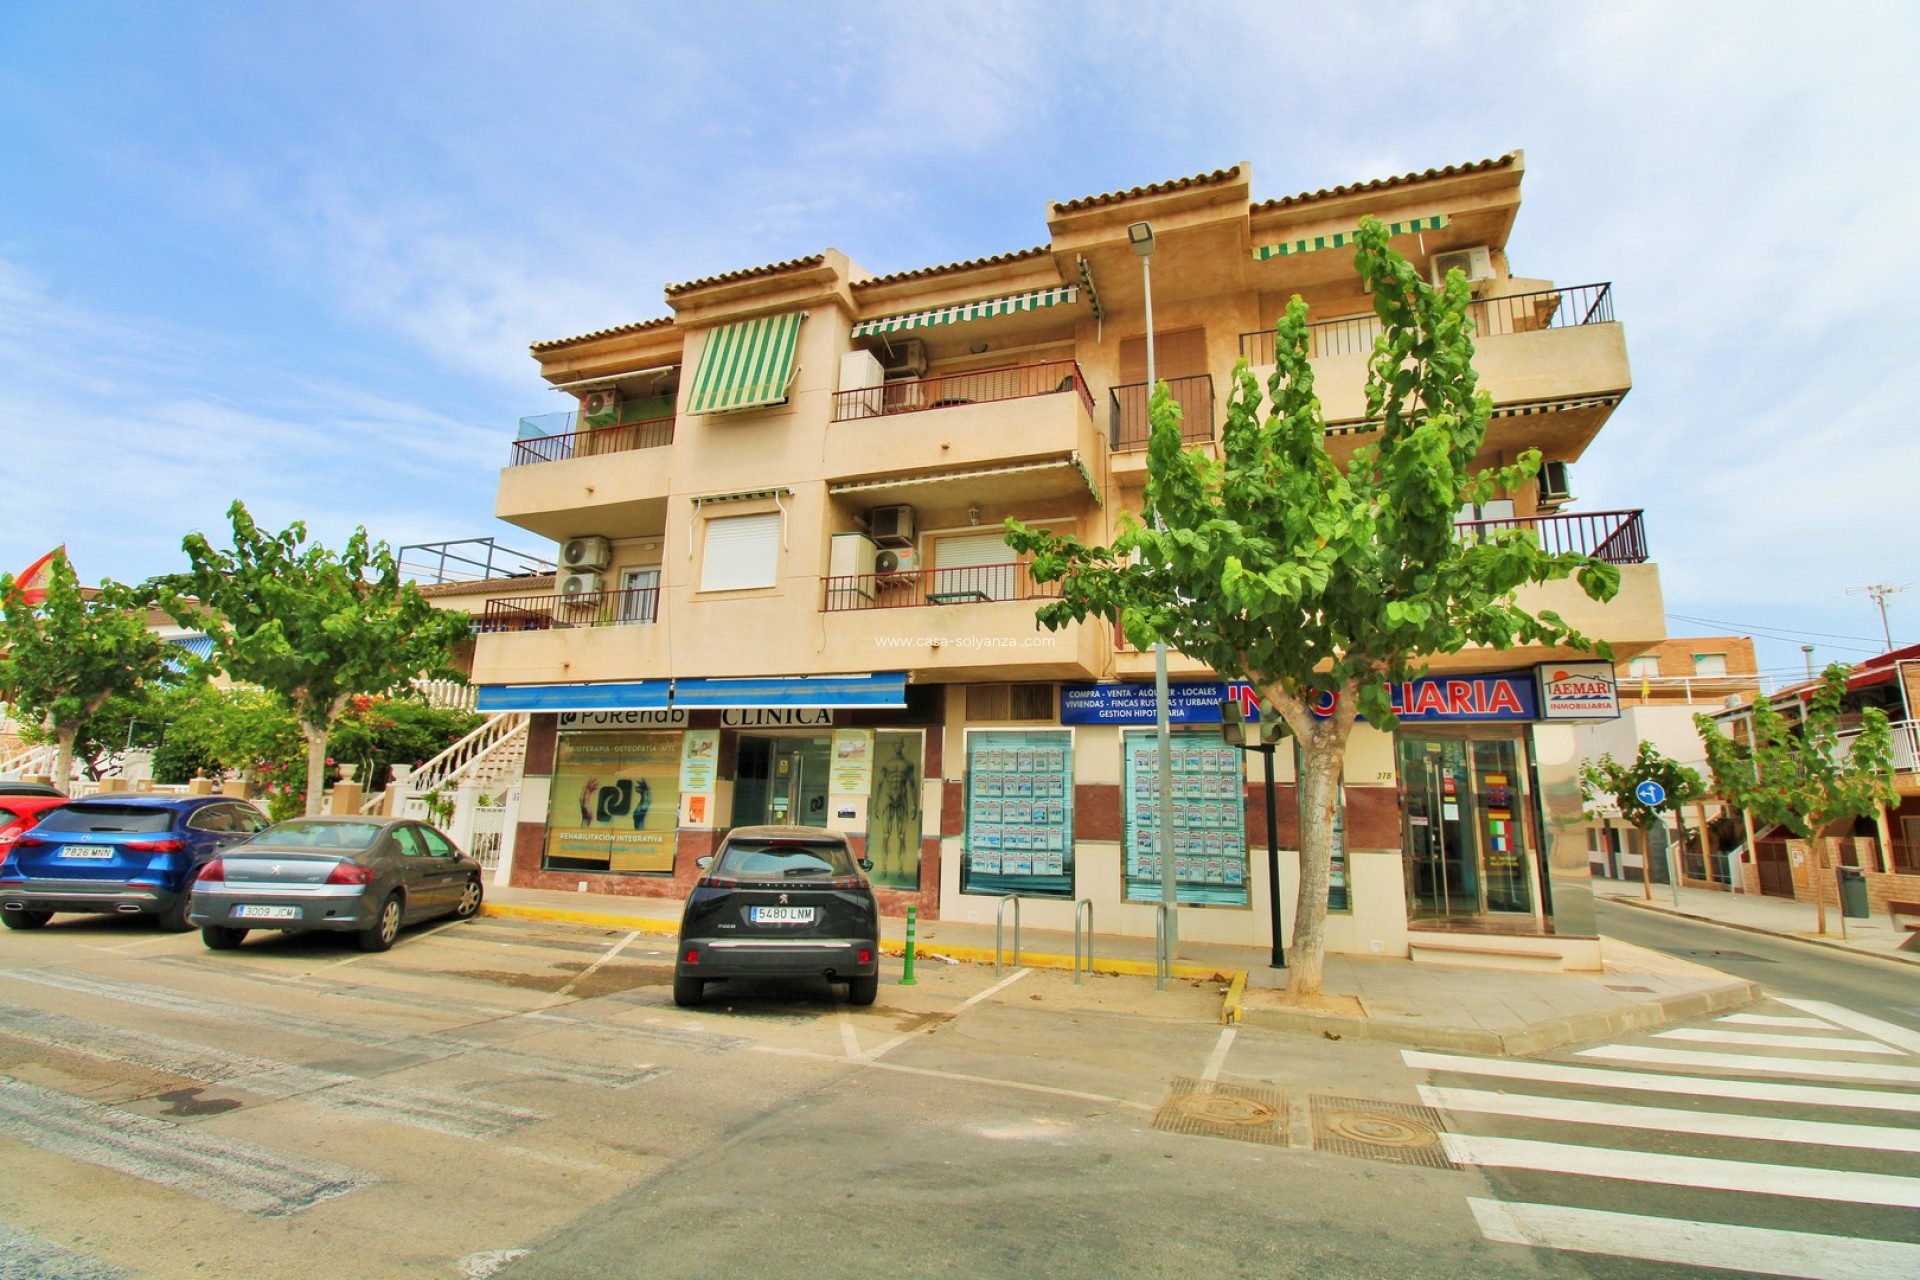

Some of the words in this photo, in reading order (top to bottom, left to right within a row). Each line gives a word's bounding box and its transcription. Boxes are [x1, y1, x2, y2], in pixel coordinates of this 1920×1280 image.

[1069, 690, 1100, 698] COMPRA
[1107, 689, 1131, 698] VENTA
[1182, 687, 1217, 696] LOCALES
[1553, 682, 1608, 695] AEMAR
[1065, 700, 1104, 708] VIVIENDAS
[1111, 699, 1139, 708] FINCAS
[1178, 698, 1185, 706] Y
[1550, 702, 1612, 710] INMOBILIARIA
[1099, 709, 1132, 718] GESTION
[617, 835, 663, 843] INTEGRATIVA
[64, 848, 89, 857] 7826
[246, 907, 270, 916] 3009
[759, 908, 788, 919] 5480
[790, 908, 812, 919] LNM
